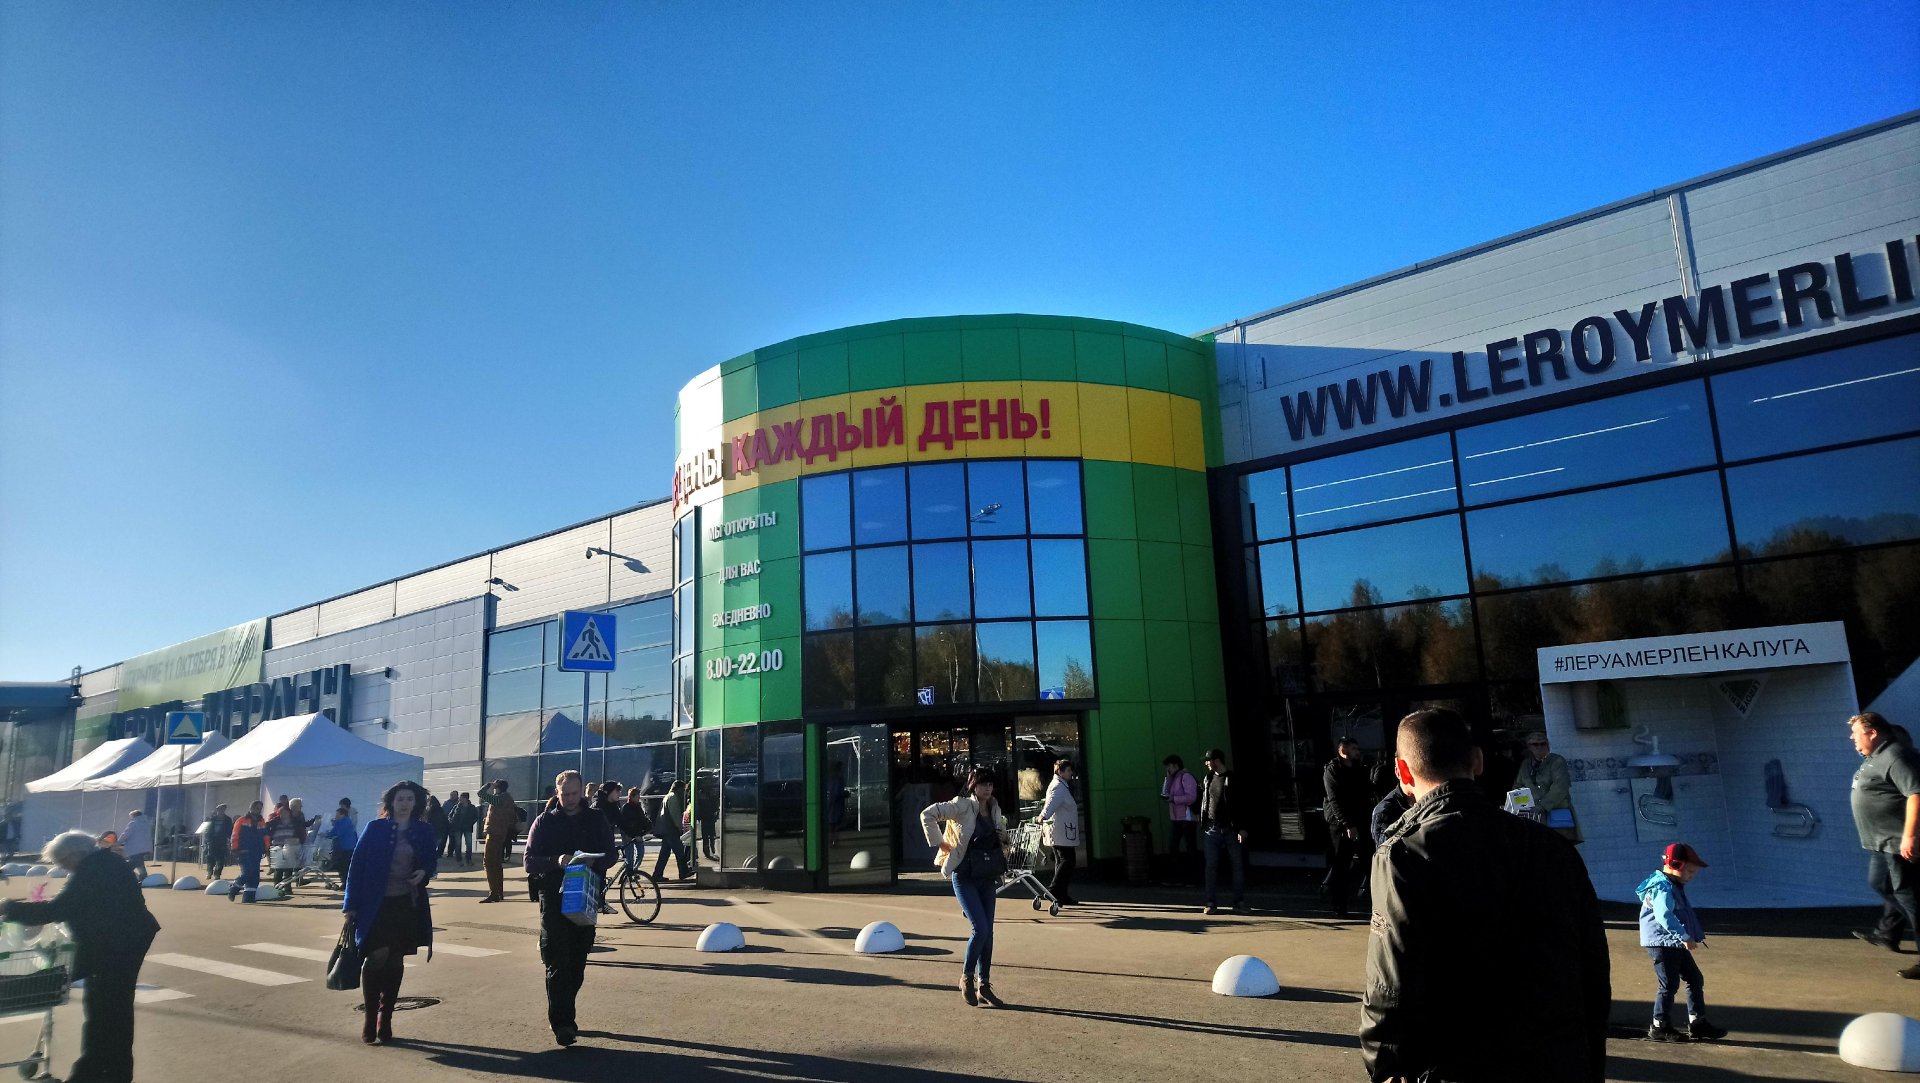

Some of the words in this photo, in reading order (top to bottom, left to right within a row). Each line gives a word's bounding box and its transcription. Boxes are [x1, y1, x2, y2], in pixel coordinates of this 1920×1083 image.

[1279, 234, 1920, 440] WWW.LEROYMERLI
[731, 396, 904, 475] КАЖДЫЙ
[918, 398, 1052, 452] ДЕНЬ!
[724, 511, 777, 536] ОТКРЫТЫ
[719, 565, 739, 584] ДЛЯ
[740, 559, 761, 577] ВАС
[712, 603, 771, 628] ЕЖЕДНЕВНО
[175, 646, 218, 680] ОКТЯБРЯ
[706, 648, 783, 680] 8.00-22.00
[1554, 638, 1811, 673] #ЛЕРУАМЕРЛЕНКАЛУГА
